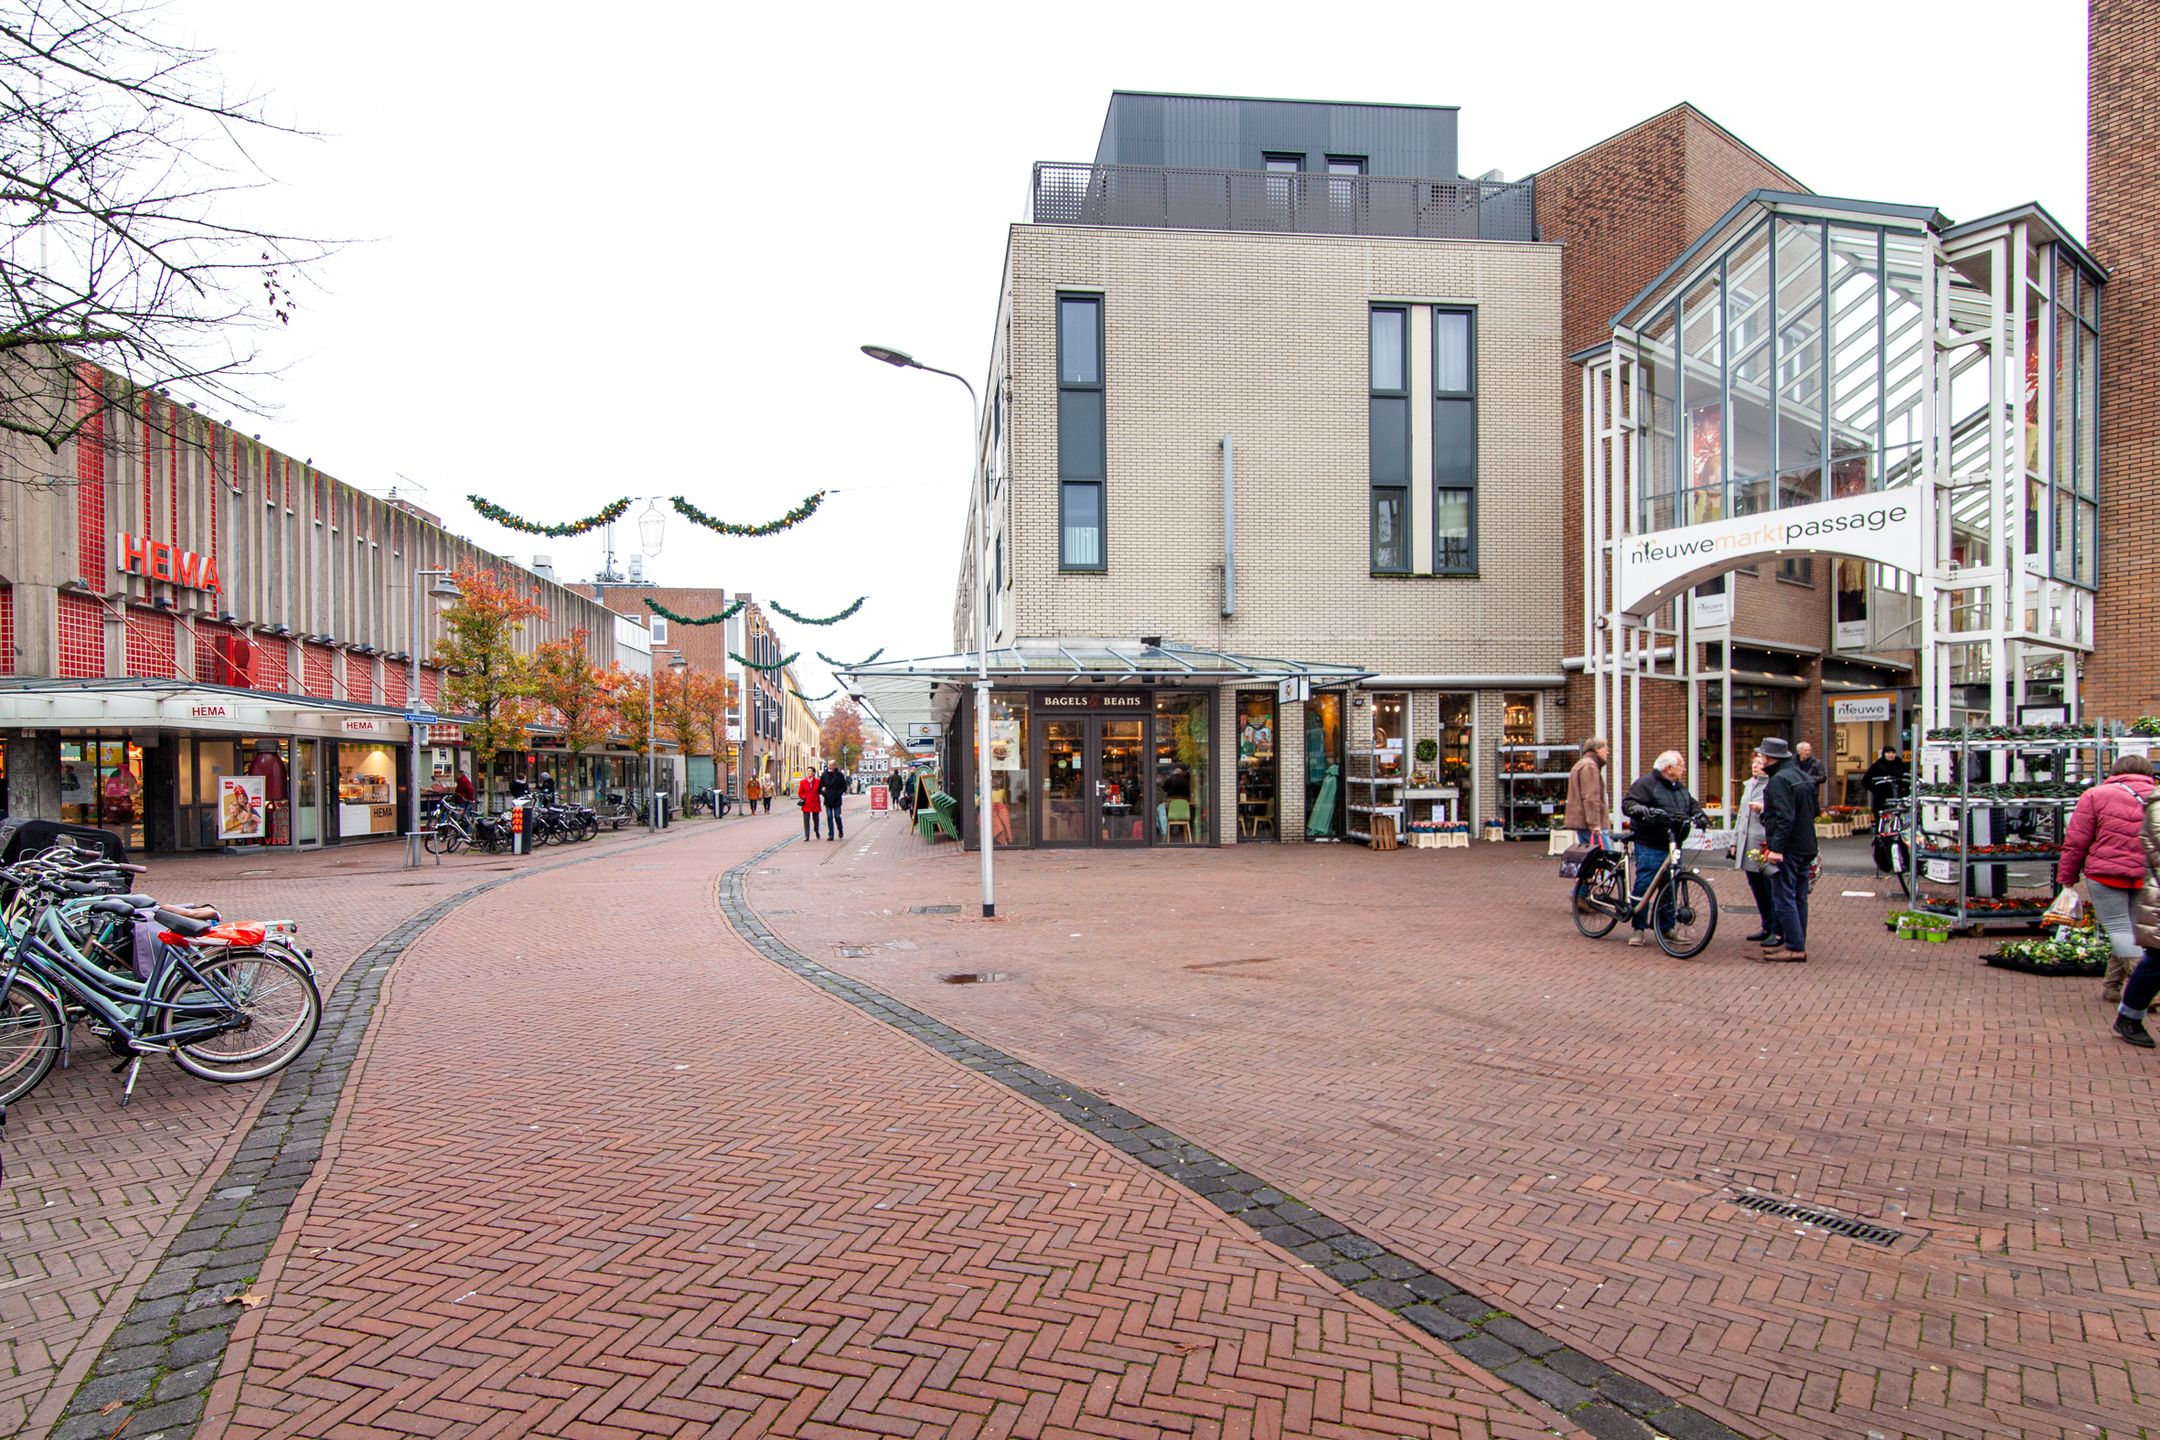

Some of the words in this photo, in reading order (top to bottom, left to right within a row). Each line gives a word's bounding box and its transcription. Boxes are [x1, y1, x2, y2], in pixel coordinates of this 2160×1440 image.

[121, 532, 222, 594] HEMA
[1044, 697, 1088, 706] BAGELS
[1103, 697, 1141, 706] BEANS
[192, 706, 226, 716] HEMA
[1838, 703, 1885, 715] nieuwe
[346, 721, 374, 730] HEMA
[373, 807, 393, 818] HEMA
